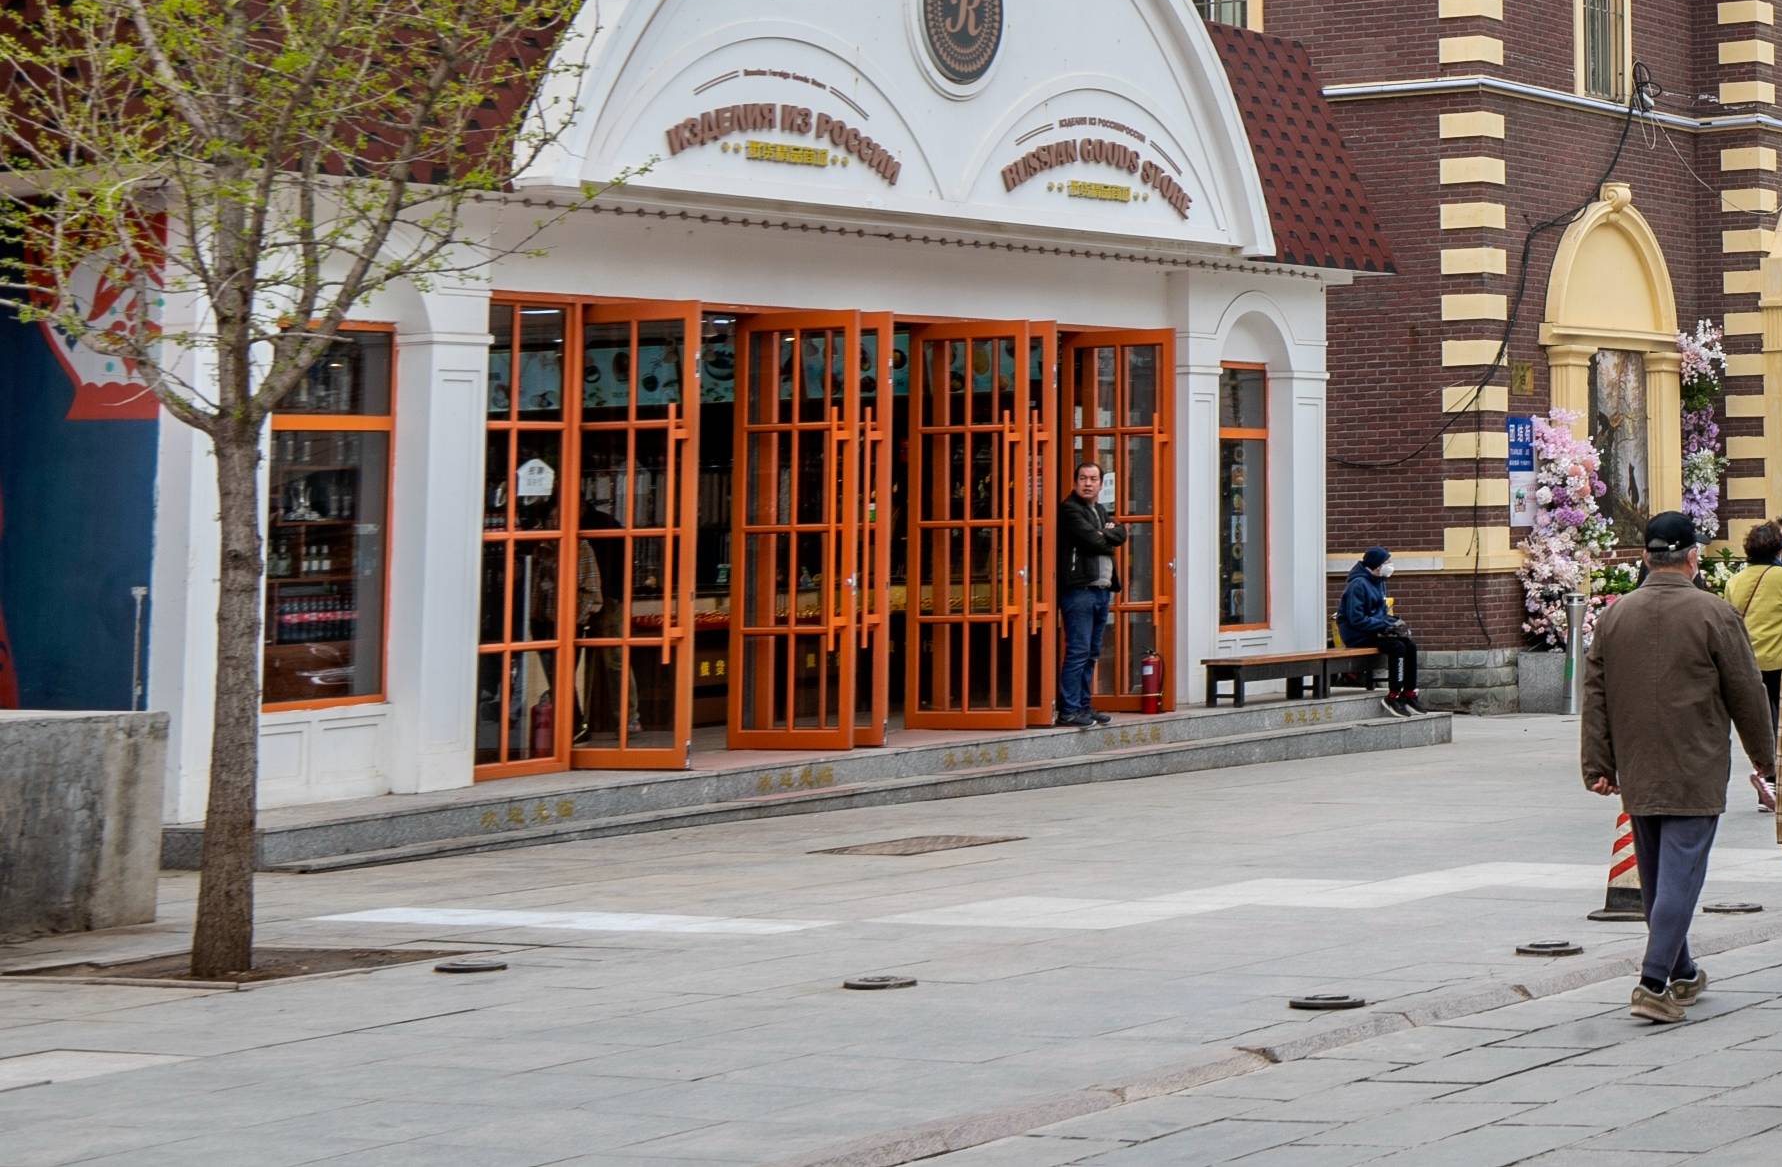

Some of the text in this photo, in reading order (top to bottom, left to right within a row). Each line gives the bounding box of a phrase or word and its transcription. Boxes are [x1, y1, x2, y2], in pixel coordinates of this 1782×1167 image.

[666, 103, 902, 186] ИЗДЕЛИЯ ИЗ РОССИИ
[1001, 138, 1193, 220] RUSSIAN GOODS STORE
[1509, 424, 1531, 442] 团结街
